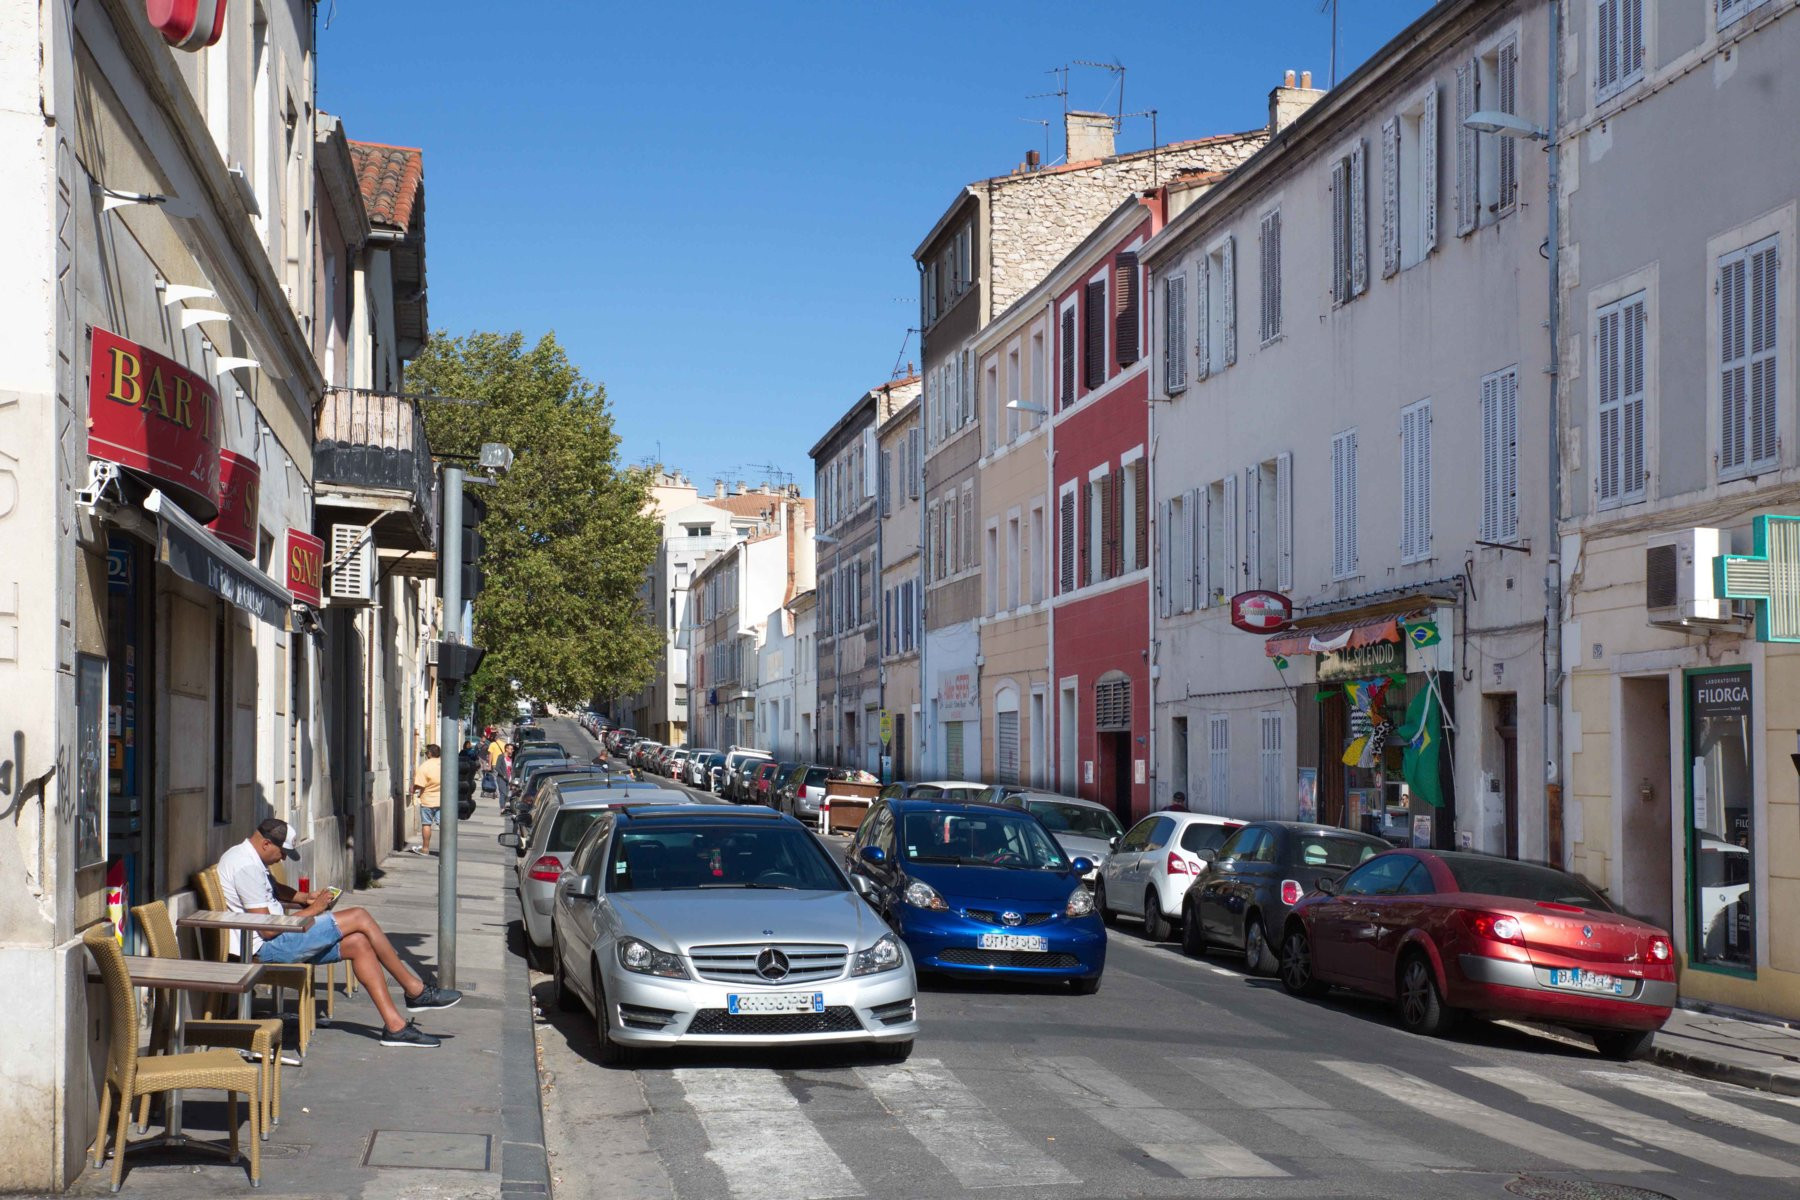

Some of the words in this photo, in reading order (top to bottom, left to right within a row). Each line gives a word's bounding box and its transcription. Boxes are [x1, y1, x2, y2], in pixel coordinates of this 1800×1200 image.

[107, 347, 193, 430] BAR
[1354, 643, 1394, 666] SPLENDID
[1698, 686, 1749, 704] FILORGA
